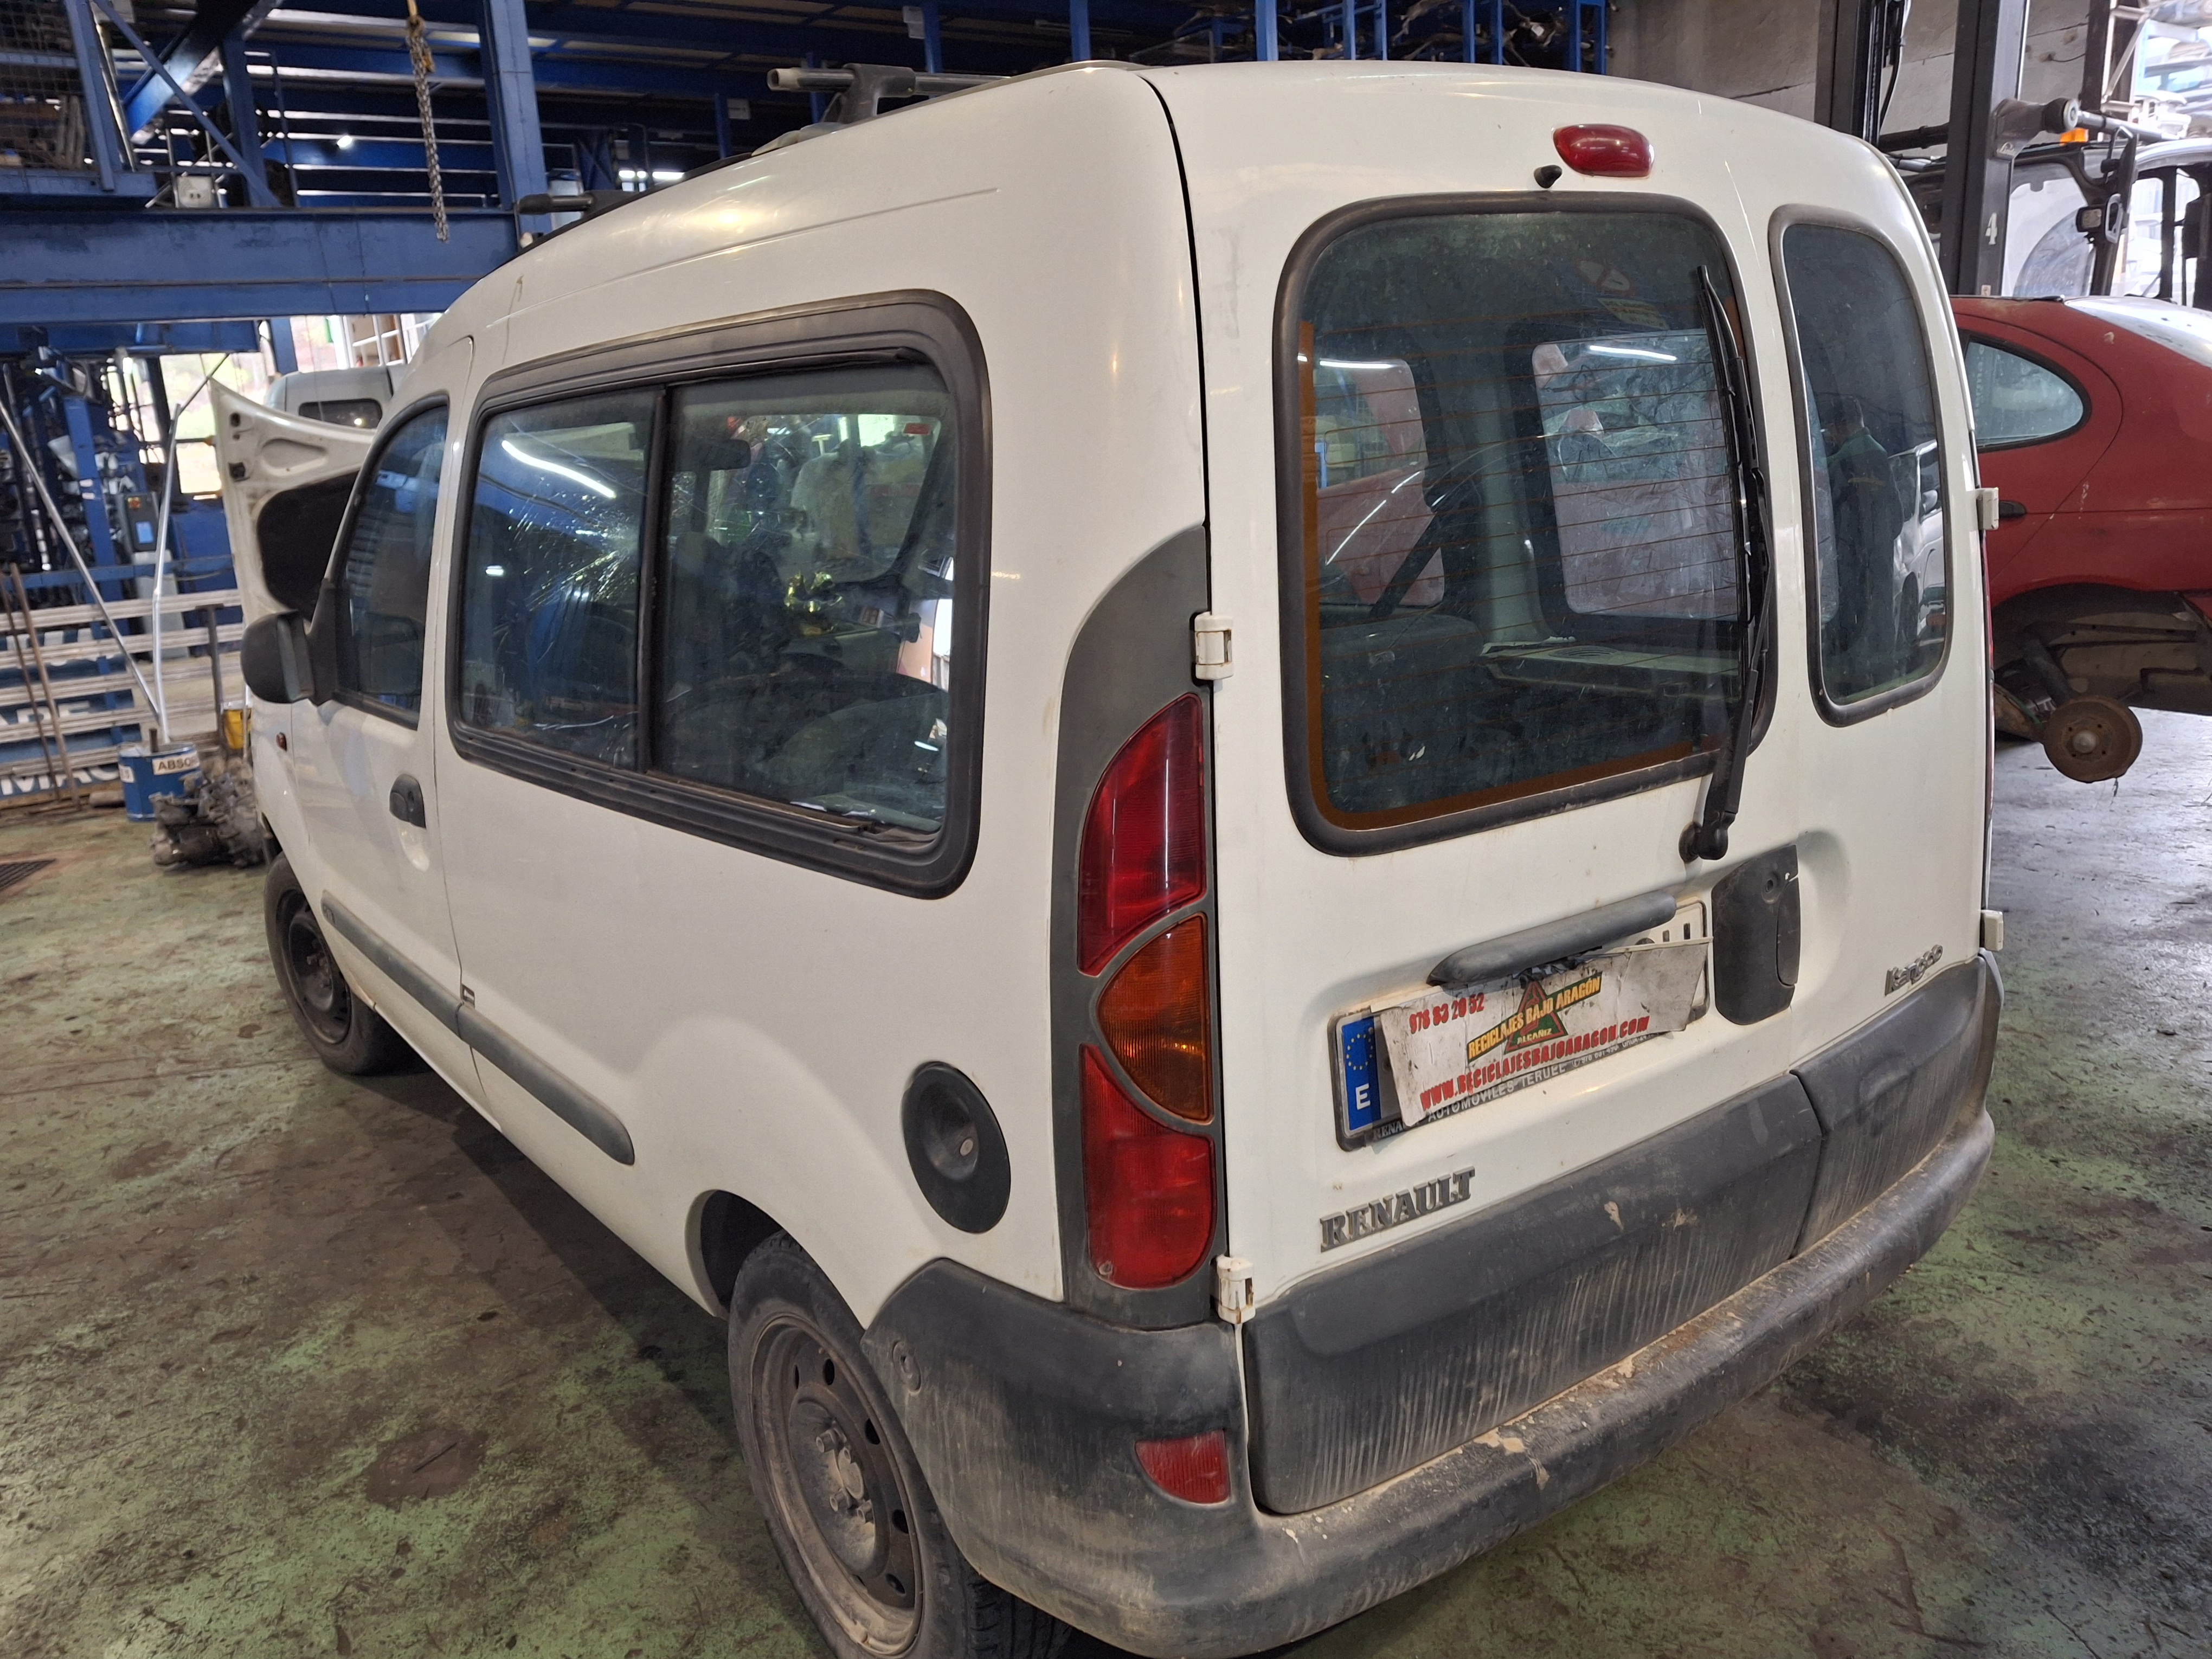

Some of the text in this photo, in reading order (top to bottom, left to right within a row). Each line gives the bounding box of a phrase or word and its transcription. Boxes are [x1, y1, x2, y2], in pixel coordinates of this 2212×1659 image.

[1985, 212, 1997, 245] 4
[158, 756, 196, 771] ABSO
[1409, 992, 1485, 1034] 978 83 20 52
[1468, 977, 1600, 1059] RECICLAJES BAJO ARAGÓN
[1516, 1028, 1552, 1045] ALCAÑIZ
[1420, 1015, 1650, 1112] WWW.RECICLAJESBAJOARAGON.COM
[1355, 1083, 1371, 1110] E
[1427, 1081, 1514, 1122] AUTOMOVILES
[1320, 1166, 1475, 1253] RENAULT
